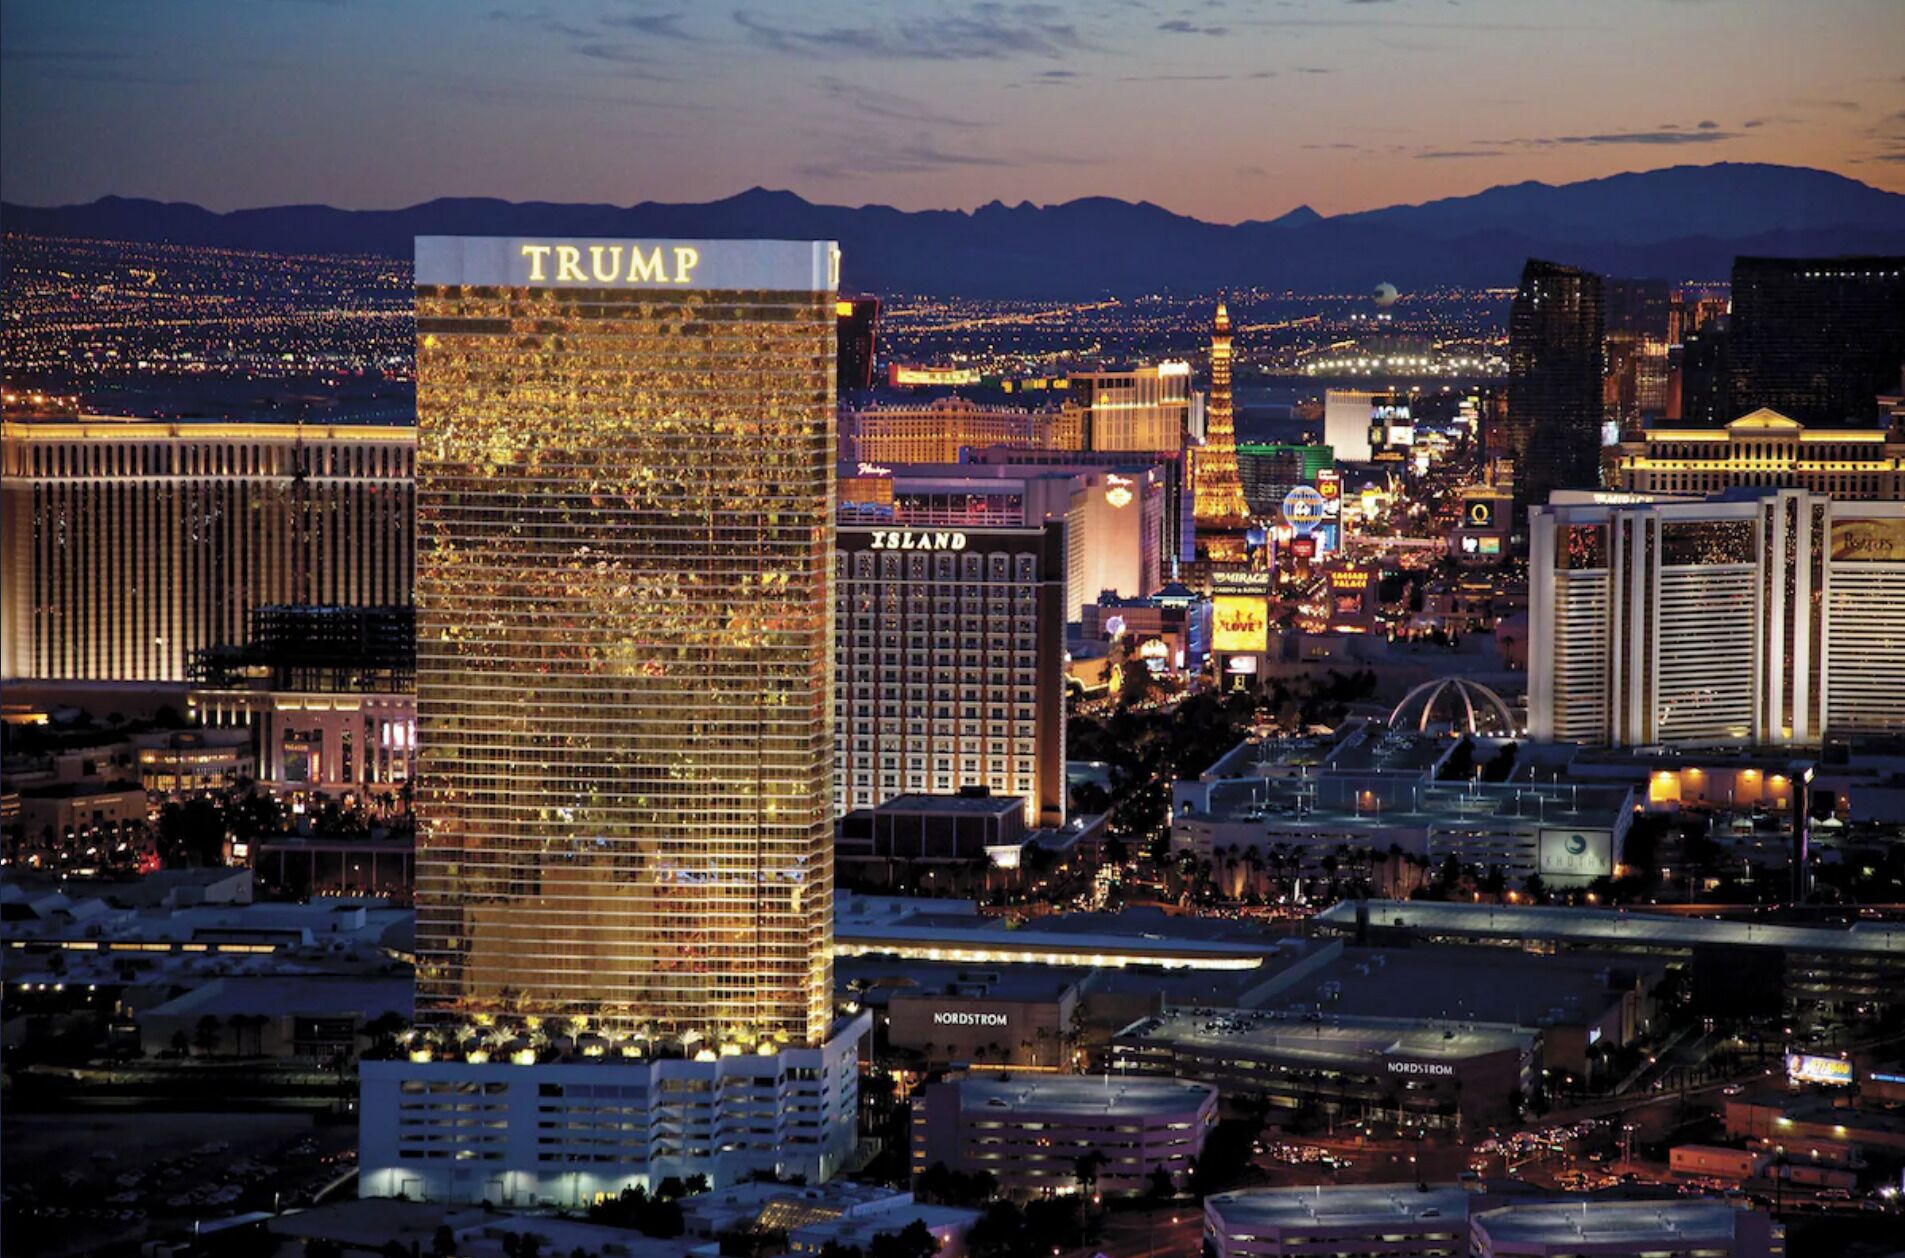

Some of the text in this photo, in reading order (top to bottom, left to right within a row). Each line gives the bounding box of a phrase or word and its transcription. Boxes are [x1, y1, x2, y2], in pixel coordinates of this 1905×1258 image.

[522, 245, 699, 282] TRUMP
[1372, 405, 1410, 419] MGM
[871, 531, 967, 550] ISLAND
[1226, 622, 1254, 632] LOVE
[934, 1012, 1008, 1026] NORDSTROM
[1387, 1062, 1453, 1075] NORDSTROM
